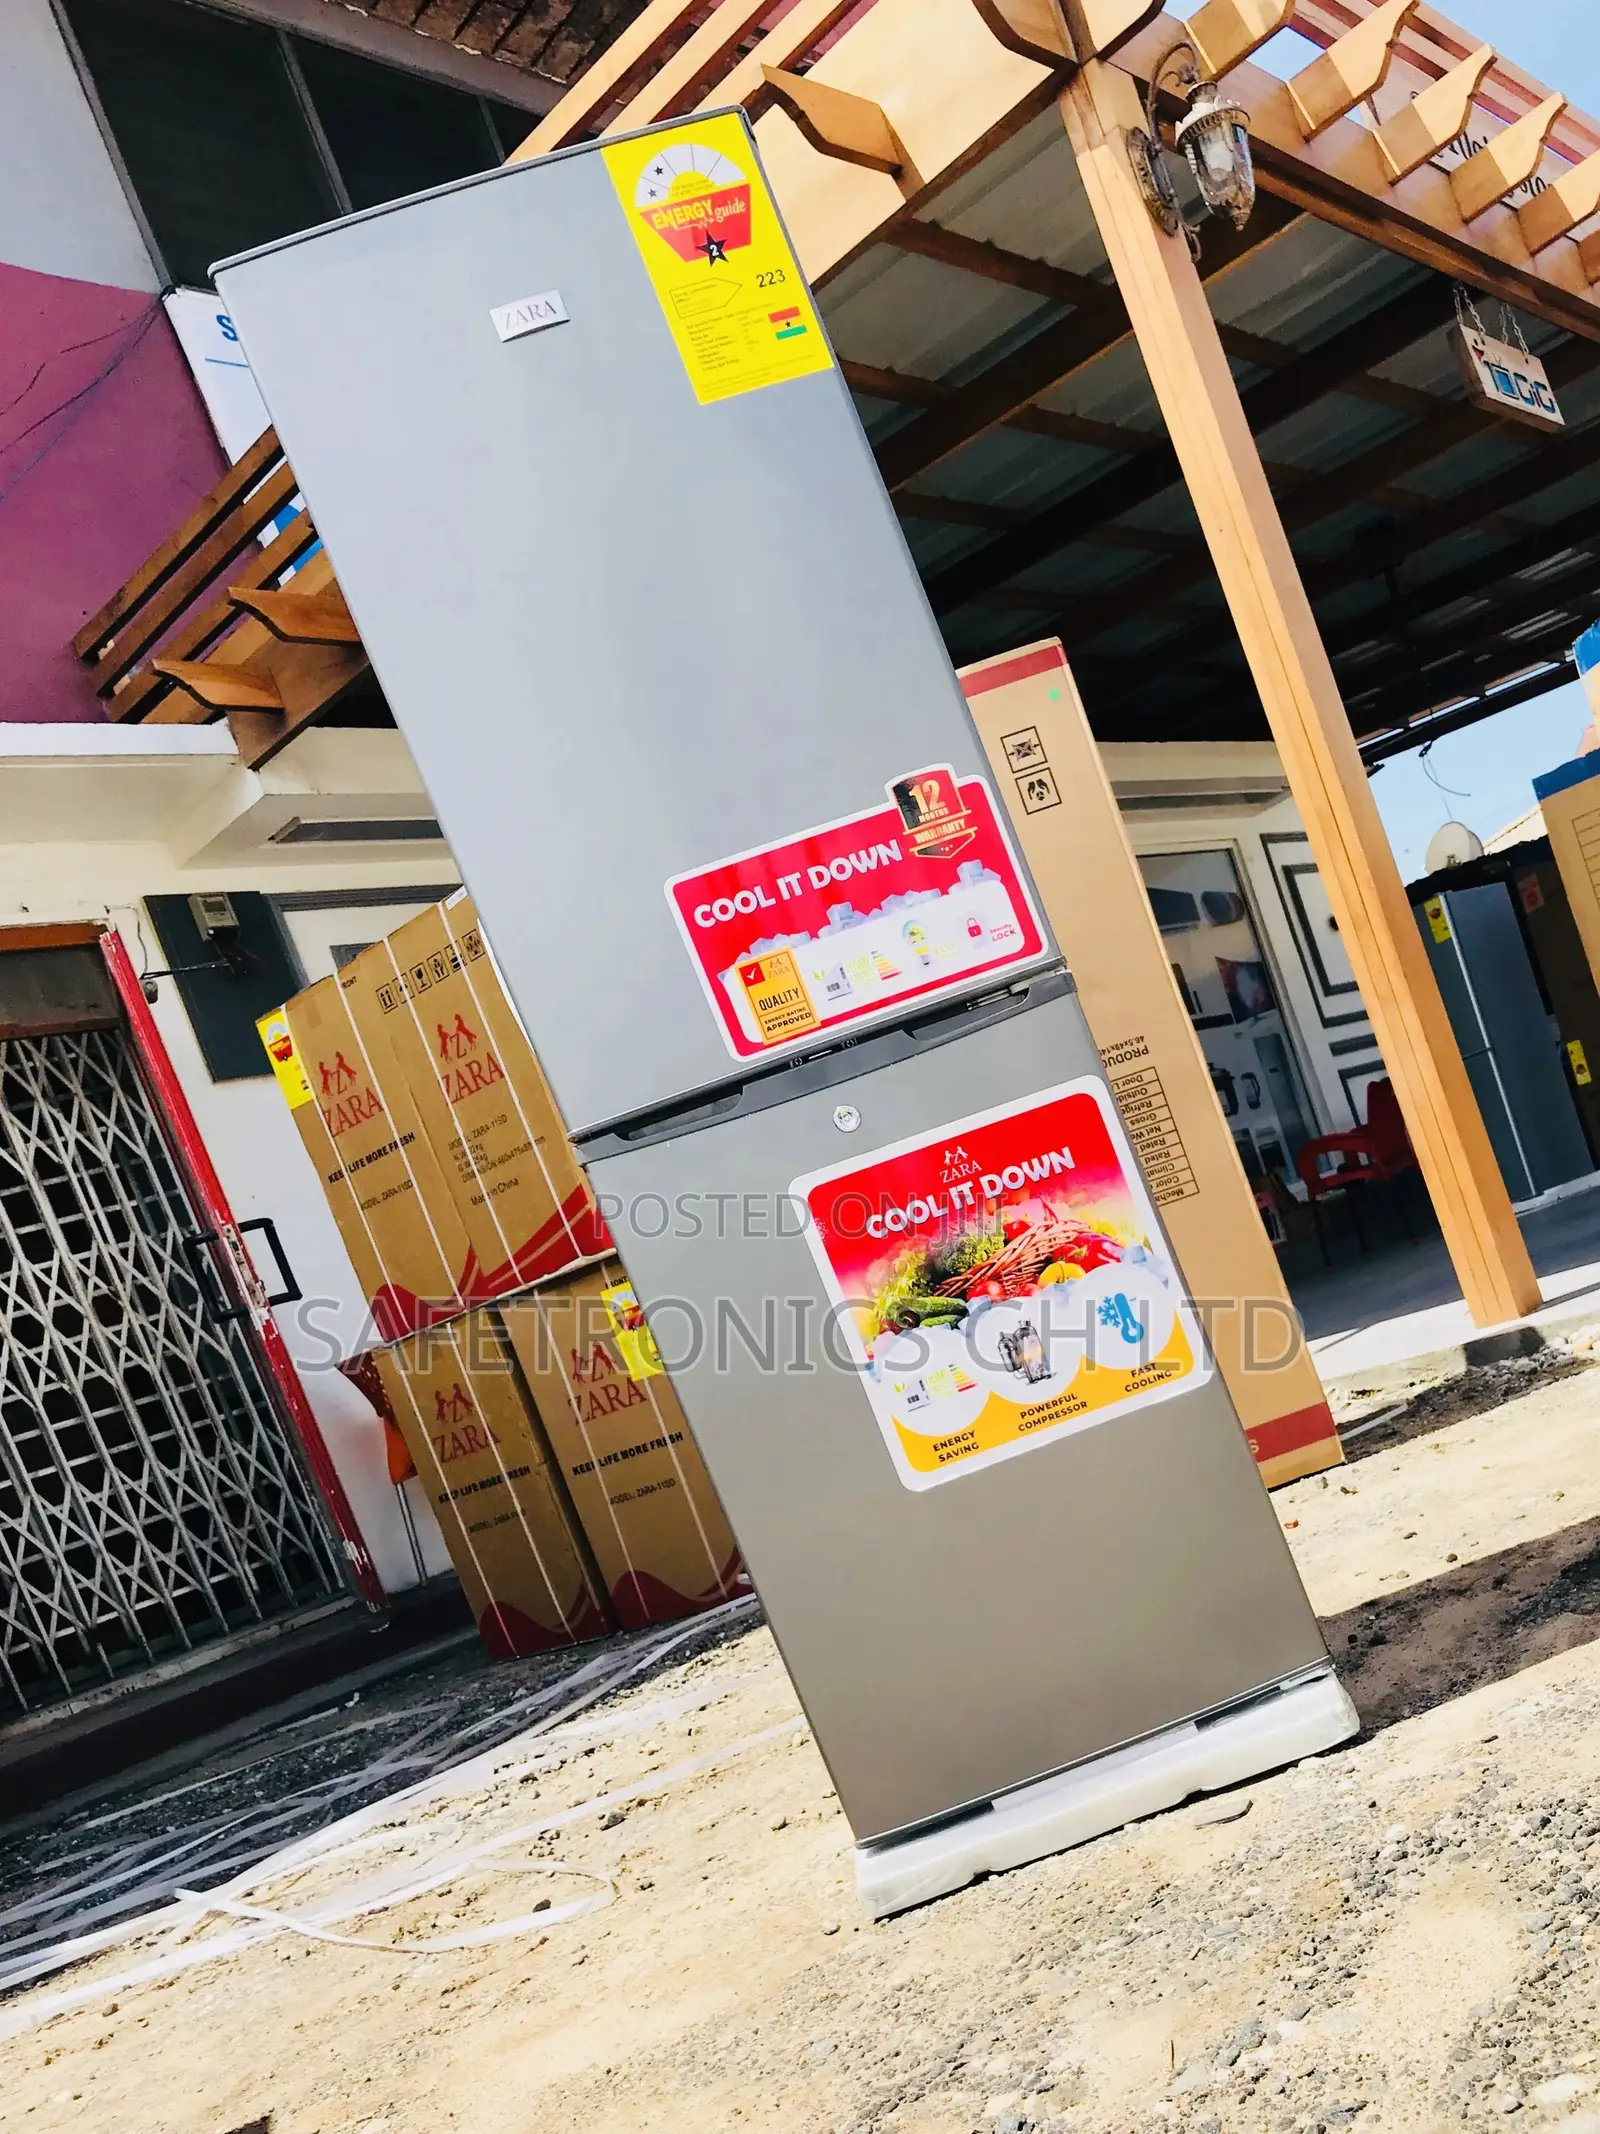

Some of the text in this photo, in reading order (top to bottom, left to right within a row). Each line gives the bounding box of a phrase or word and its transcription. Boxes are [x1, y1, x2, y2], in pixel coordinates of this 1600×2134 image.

[651, 197, 746, 230] ENERGY guide
[709, 244, 720, 257] 2
[756, 269, 786, 288] 223
[500, 300, 558, 330] ZARA
[908, 779, 946, 815] 12
[918, 806, 950, 823] MONTHS
[913, 818, 966, 844] WARRANTY
[693, 838, 904, 929] COOL IT DOWN
[991, 928, 1017, 943] LOCK
[341, 976, 358, 990] RONT
[768, 965, 790, 979] ZARA
[758, 987, 801, 1012] QUALITY
[764, 1007, 807, 1025] ENERGY RATING
[766, 1012, 812, 1033] APPROVED
[1102, 1044, 1149, 1069] PRODUC
[438, 1051, 505, 1107] ZARA
[1121, 1074, 1144, 1087] Door
[1117, 1087, 1148, 1104] Outsid
[323, 1086, 384, 1138] ZARA
[1129, 1112, 1157, 1126] Gross
[1146, 1125, 1162, 1135] Net
[1140, 1137, 1167, 1152] Rated
[328, 1166, 348, 1184] KEE
[348, 1158, 366, 1174] LIFE
[365, 1146, 389, 1165] MORE
[1144, 1150, 1171, 1165] Rated
[939, 1159, 983, 1184] ZARA
[1155, 1175, 1180, 1188] Color
[498, 1177, 519, 1194] China
[866, 1146, 1076, 1239] COOL IT DOWN
[1124, 1369, 1172, 1393] COOLING
[1130, 1362, 1157, 1378] FAST
[567, 1377, 647, 1426] ZARA
[1019, 1393, 1078, 1419] POWERFUL
[1018, 1401, 1088, 1432] COMPRESSOR
[432, 1424, 501, 1464] ZARA
[933, 1430, 976, 1452] ENERGY
[938, 1442, 980, 1463] SAVING
[600, 1453, 620, 1467] LIFE
[621, 1442, 649, 1460] MORE
[460, 1483, 478, 1496] LIFE
[478, 1475, 503, 1490] MORE
[506, 1465, 531, 1481] RESH
